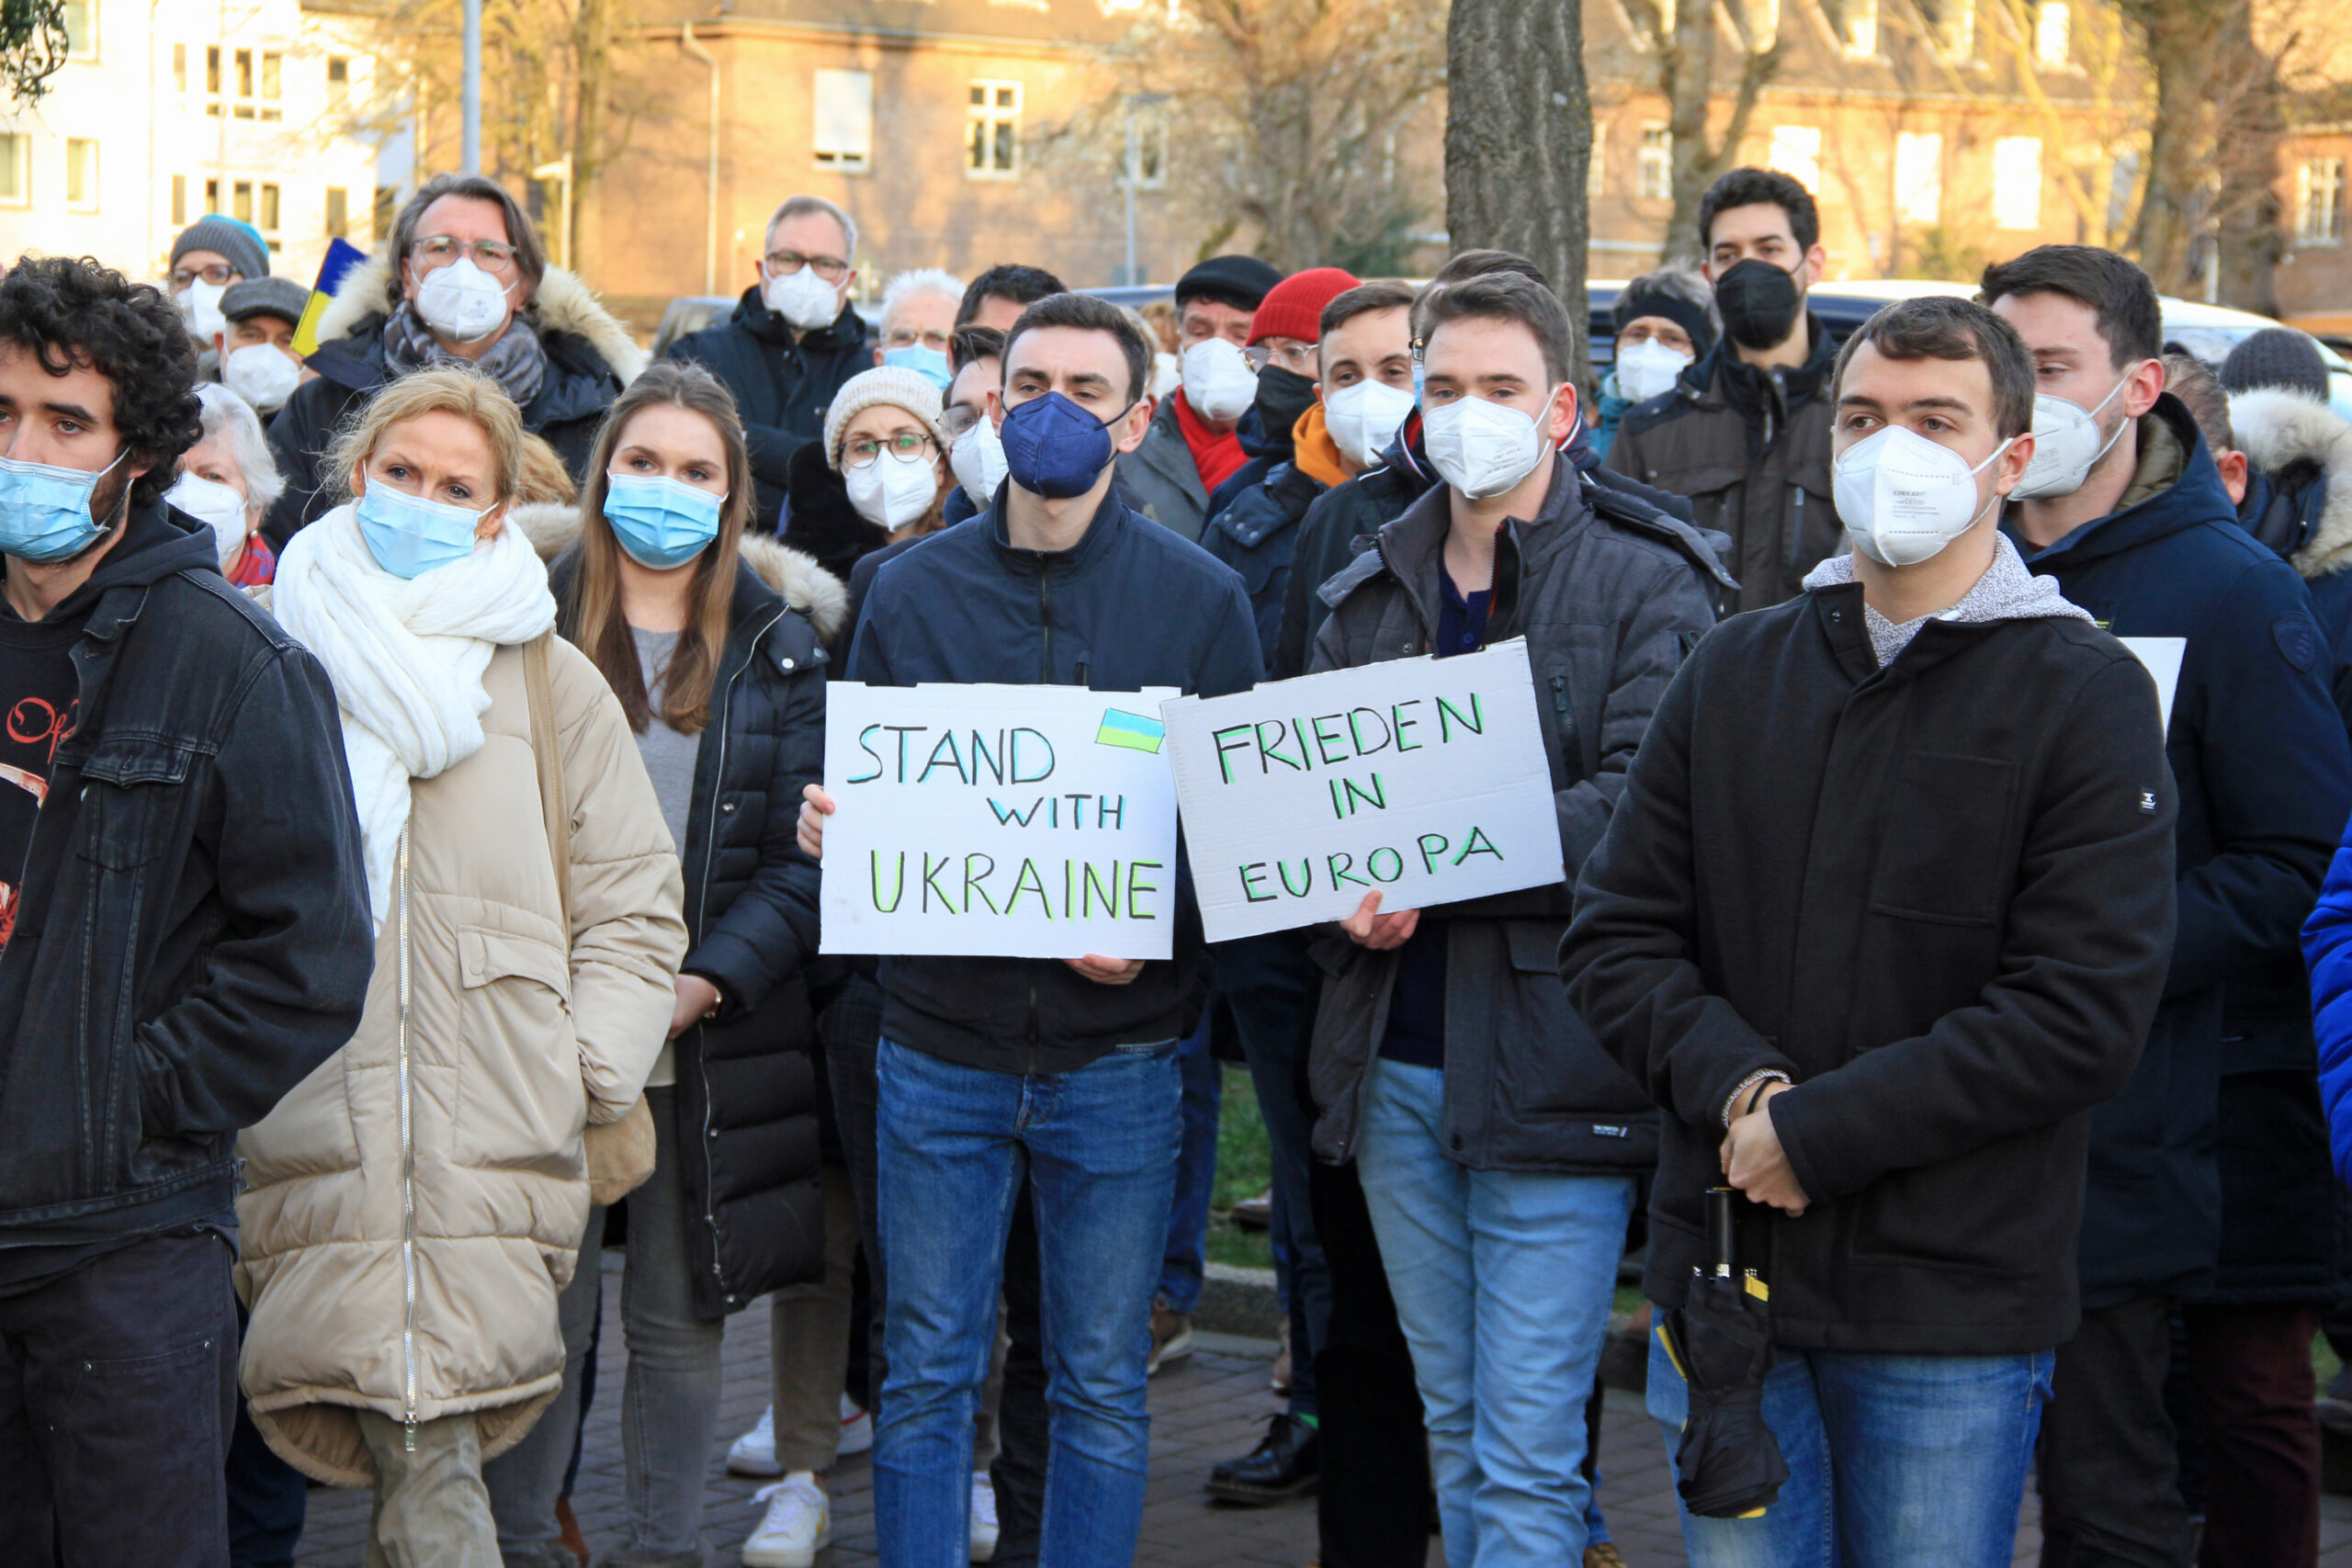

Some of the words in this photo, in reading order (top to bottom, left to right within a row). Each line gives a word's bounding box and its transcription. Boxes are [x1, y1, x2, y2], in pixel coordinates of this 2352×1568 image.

[847, 725, 1055, 784] STAND
[1212, 693, 1483, 784] FRIEDEN
[988, 795, 1126, 830] WITH
[1329, 773, 1385, 818] IN
[872, 851, 1162, 920] UKRAINE
[1239, 827, 1504, 903] EUROPA
